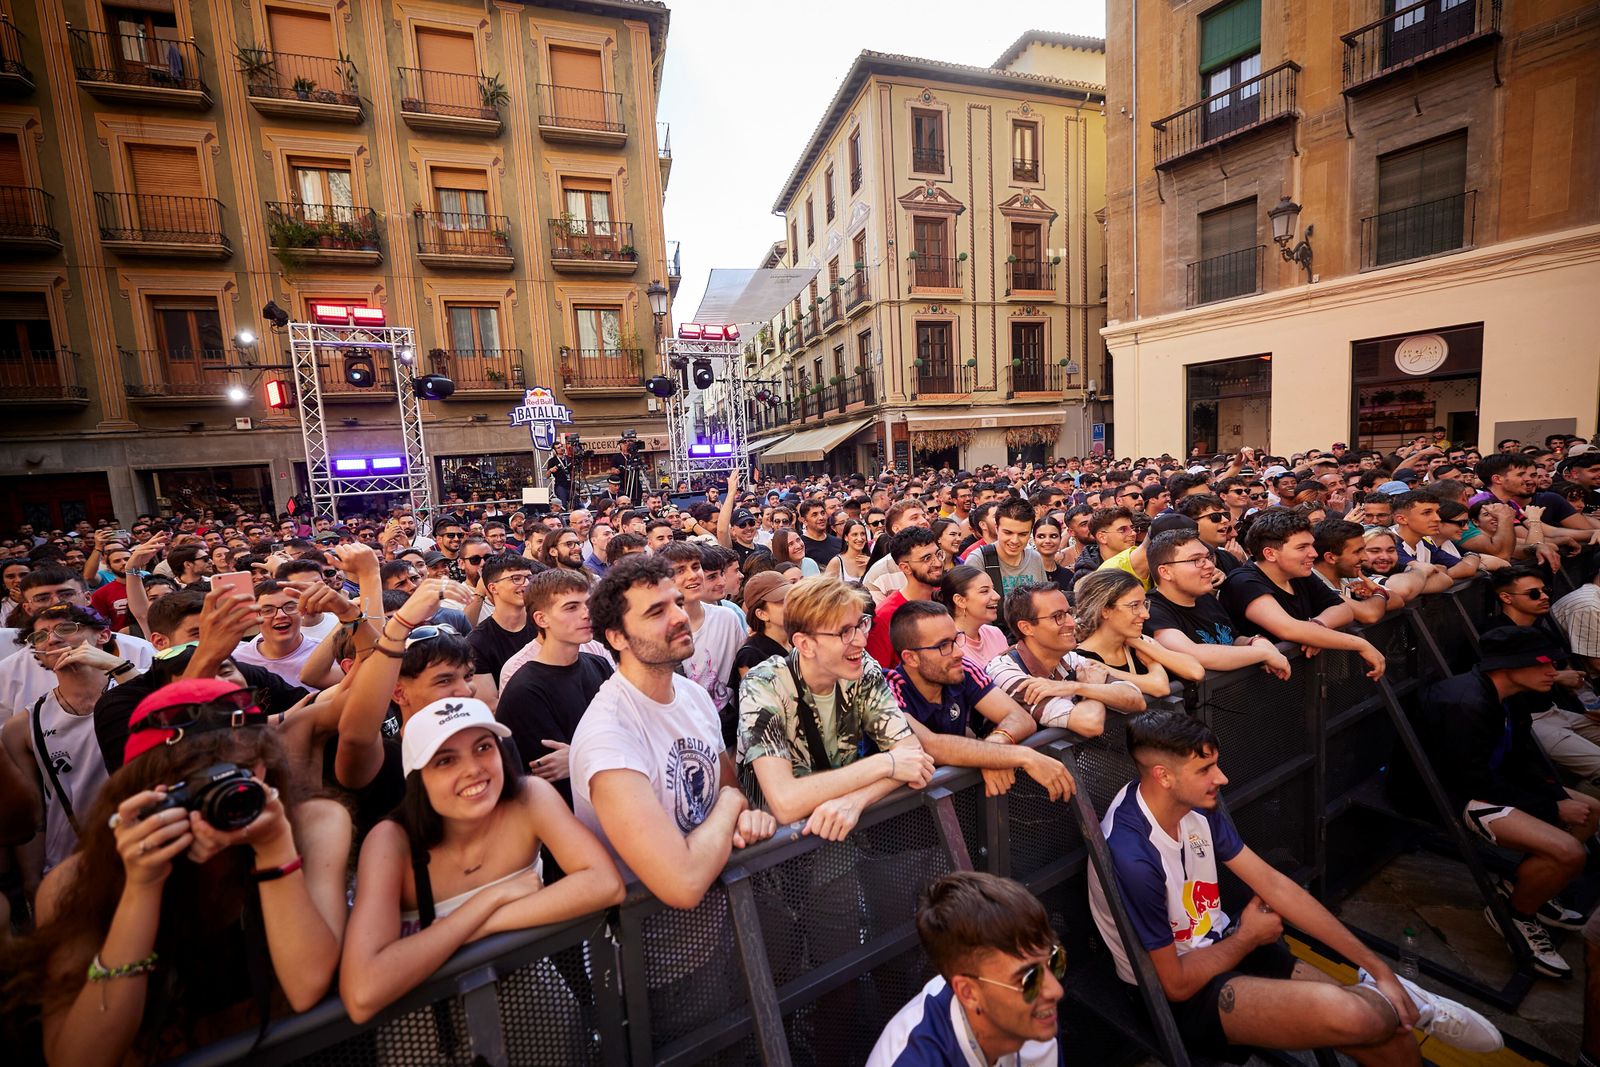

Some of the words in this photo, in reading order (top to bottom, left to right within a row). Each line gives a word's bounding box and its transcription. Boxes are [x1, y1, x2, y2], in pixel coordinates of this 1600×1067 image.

[526, 398, 540, 406] Red
[517, 406, 565, 421] BATALLA
[438, 712, 471, 726] adidas
[665, 737, 717, 790] UNIVERSIDAD
